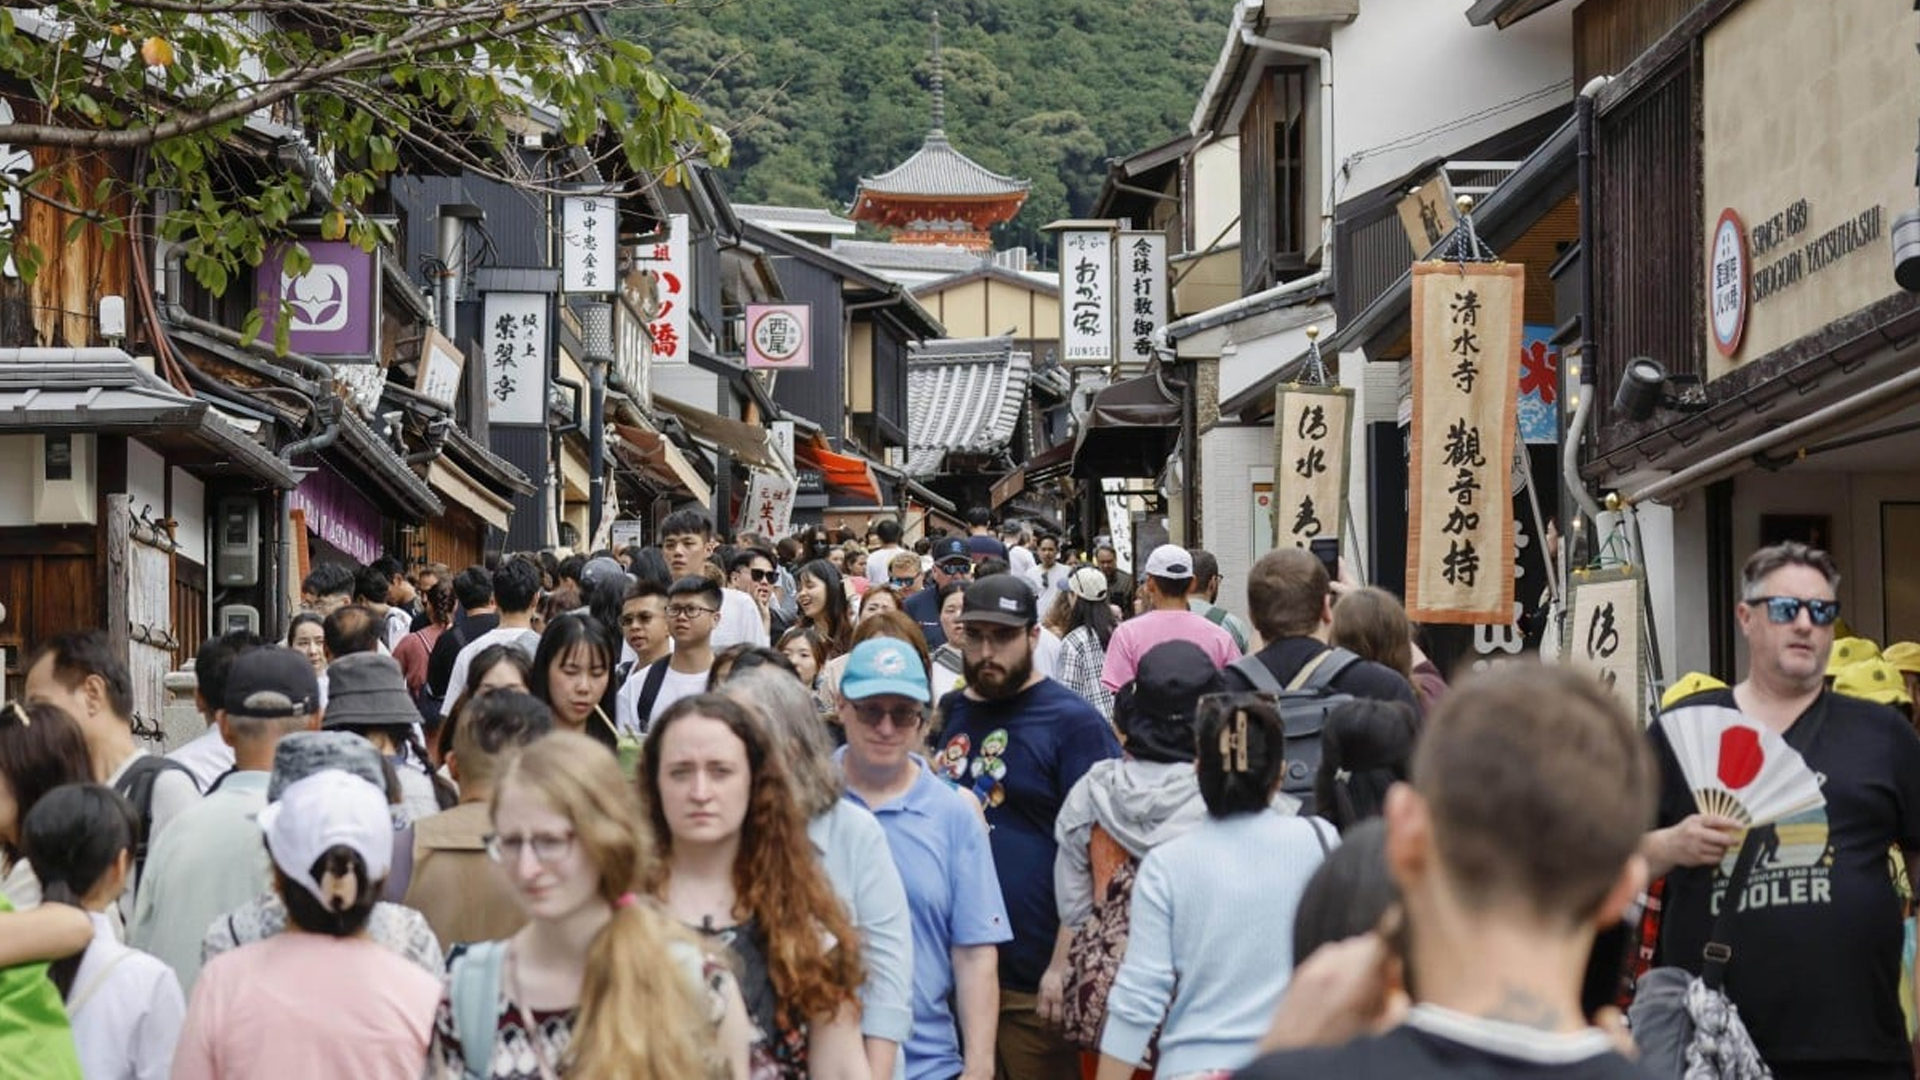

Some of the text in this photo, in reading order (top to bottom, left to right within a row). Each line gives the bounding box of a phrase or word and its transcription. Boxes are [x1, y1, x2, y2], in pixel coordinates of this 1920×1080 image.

[1752, 212, 1783, 258] SINCE
[1753, 249, 1802, 303] SHOGOIN
[1806, 204, 1880, 274] YATSUHASHI
[768, 317, 788, 354] 西尾
[1450, 289, 1482, 394] 清水寺
